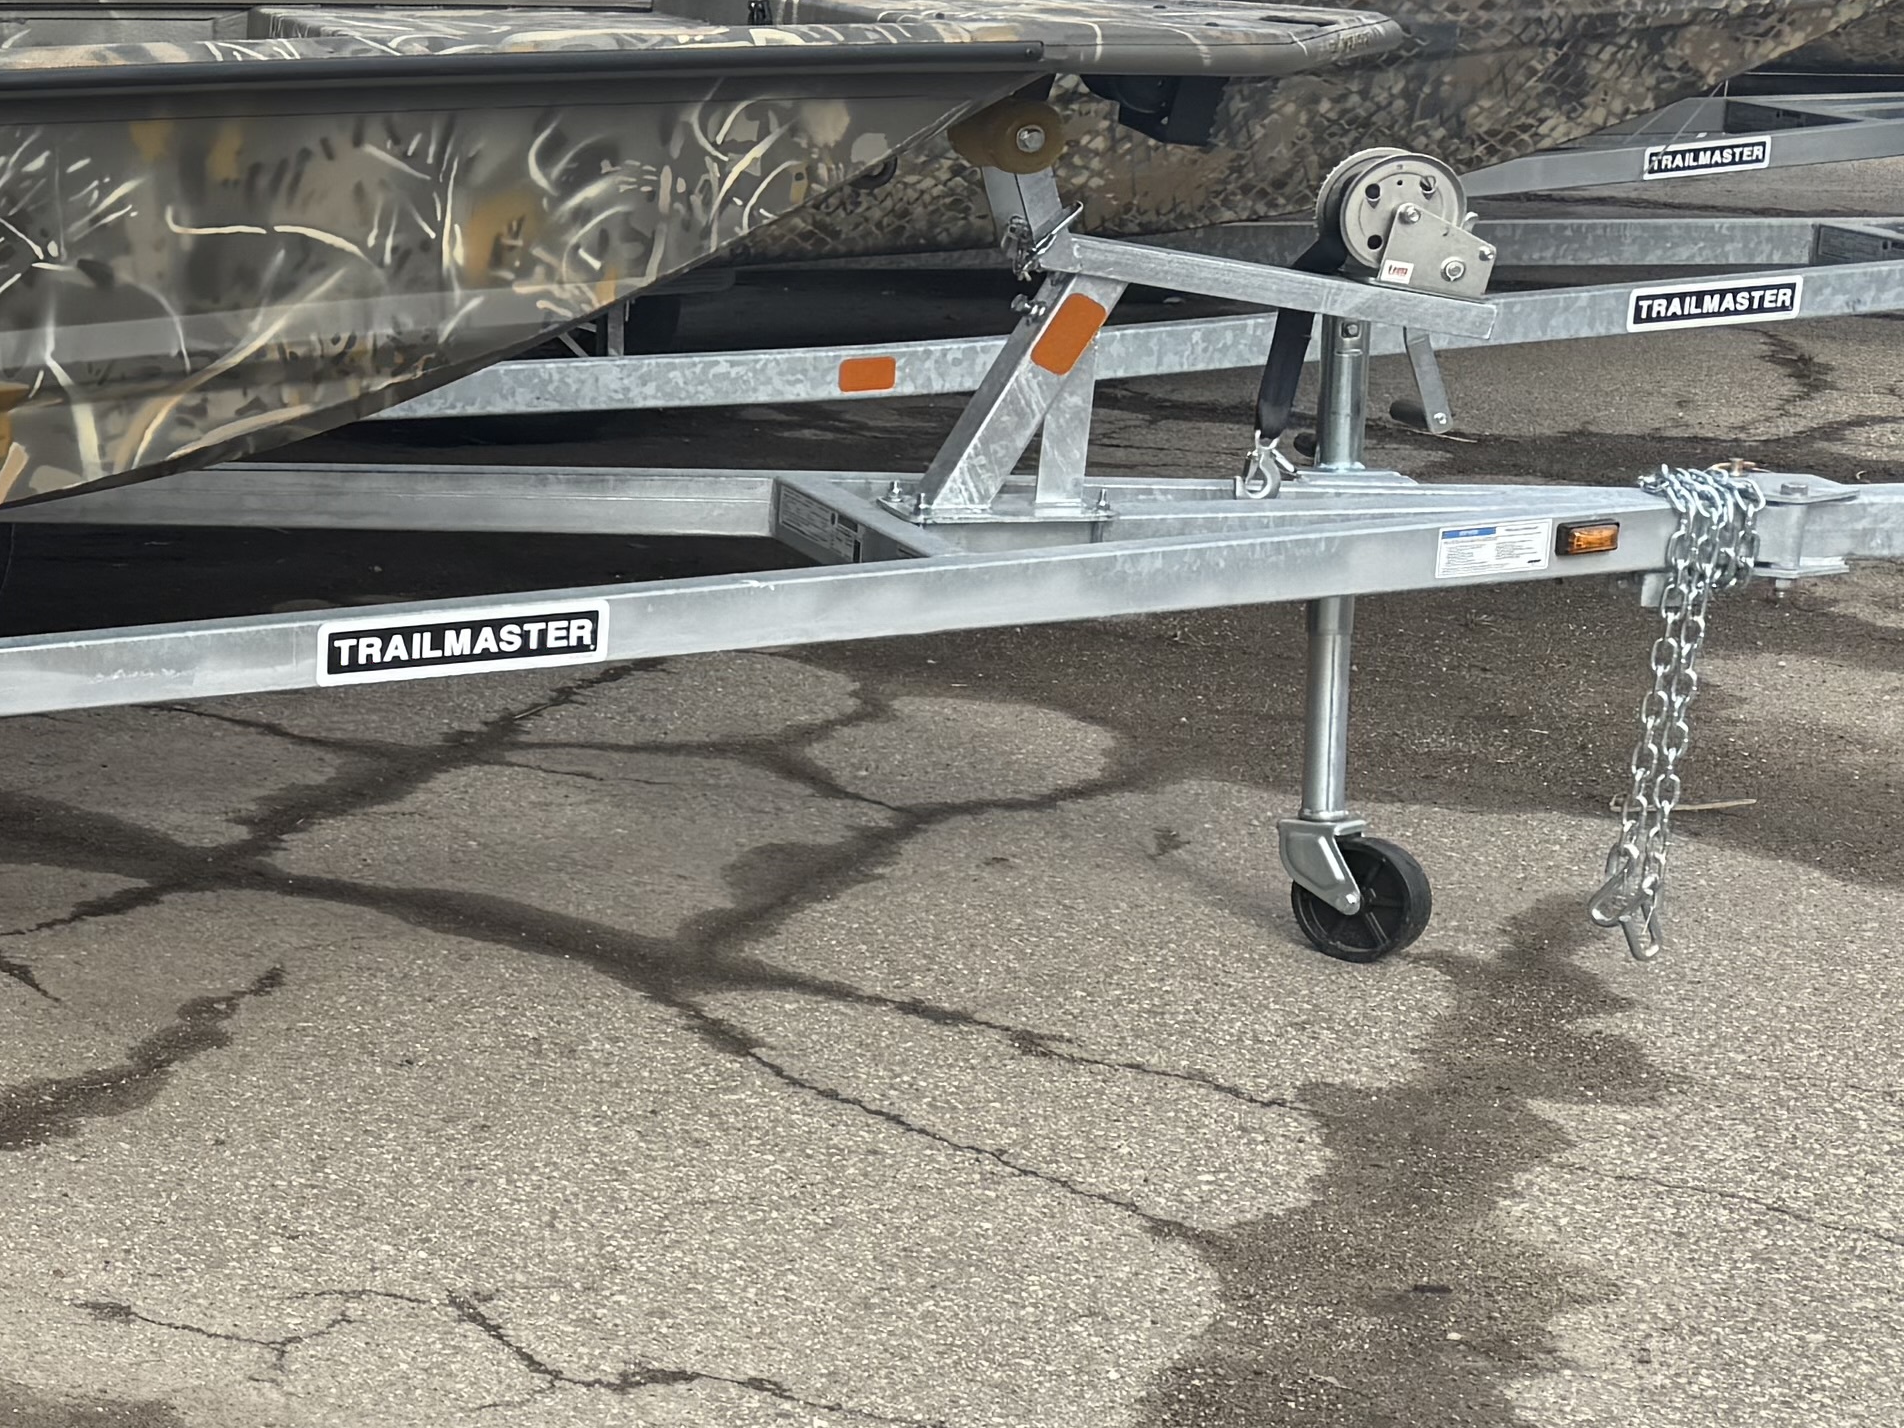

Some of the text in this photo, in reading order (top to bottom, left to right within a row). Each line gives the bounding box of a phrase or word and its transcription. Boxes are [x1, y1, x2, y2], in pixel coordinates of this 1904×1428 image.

[1652, 145, 1764, 171] TRAILMASTER
[1639, 288, 1792, 319] TRAILMASTER
[333, 618, 594, 667] TRAILMASTER
